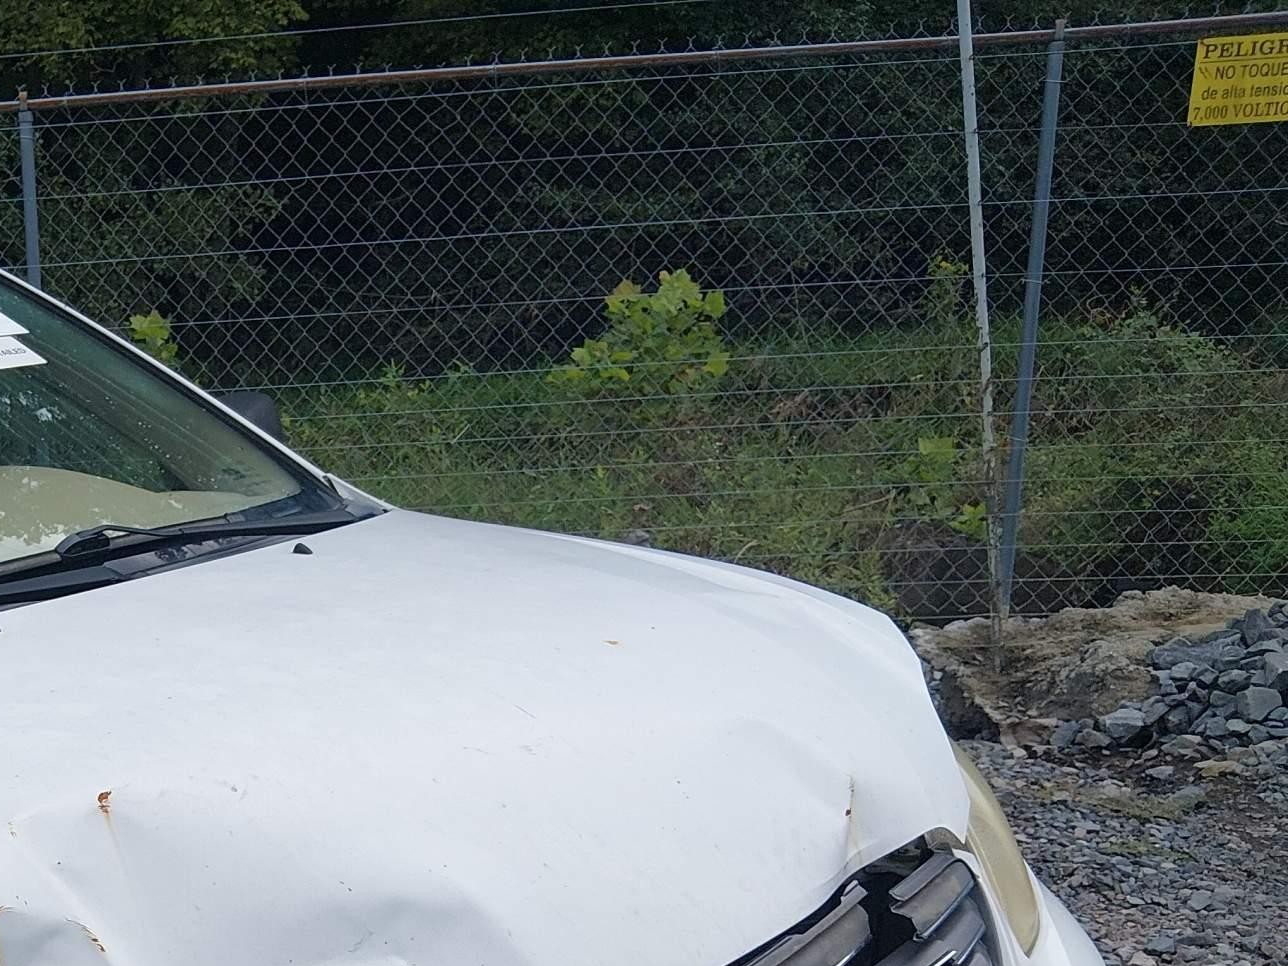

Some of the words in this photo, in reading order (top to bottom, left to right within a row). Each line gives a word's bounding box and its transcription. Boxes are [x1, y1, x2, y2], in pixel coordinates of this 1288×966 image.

[1214, 65, 1236, 80] NO
[1240, 62, 1288, 78] TOQUE
[1201, 86, 1218, 100] de
[1221, 85, 1246, 99] alta
